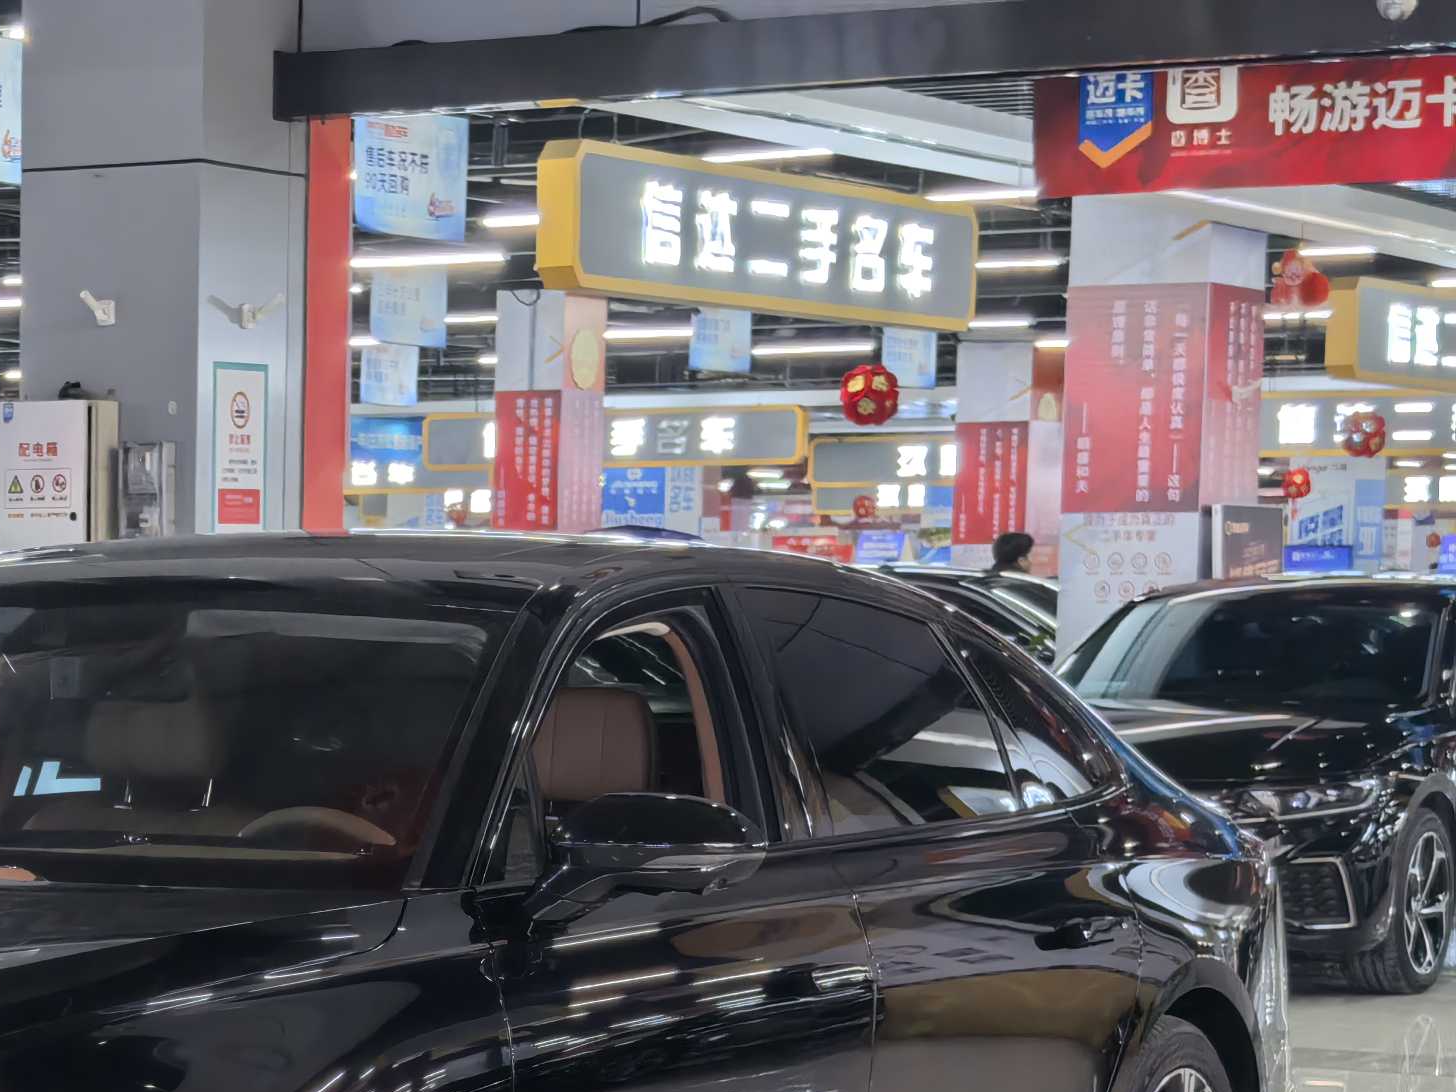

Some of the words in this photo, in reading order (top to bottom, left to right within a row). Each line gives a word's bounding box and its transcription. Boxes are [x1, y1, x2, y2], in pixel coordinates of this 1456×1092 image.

[1087, 73, 1145, 104] 迈卡
[641, 181, 935, 298] 信达二手名车
[18, 441, 58, 457] 配电箱
